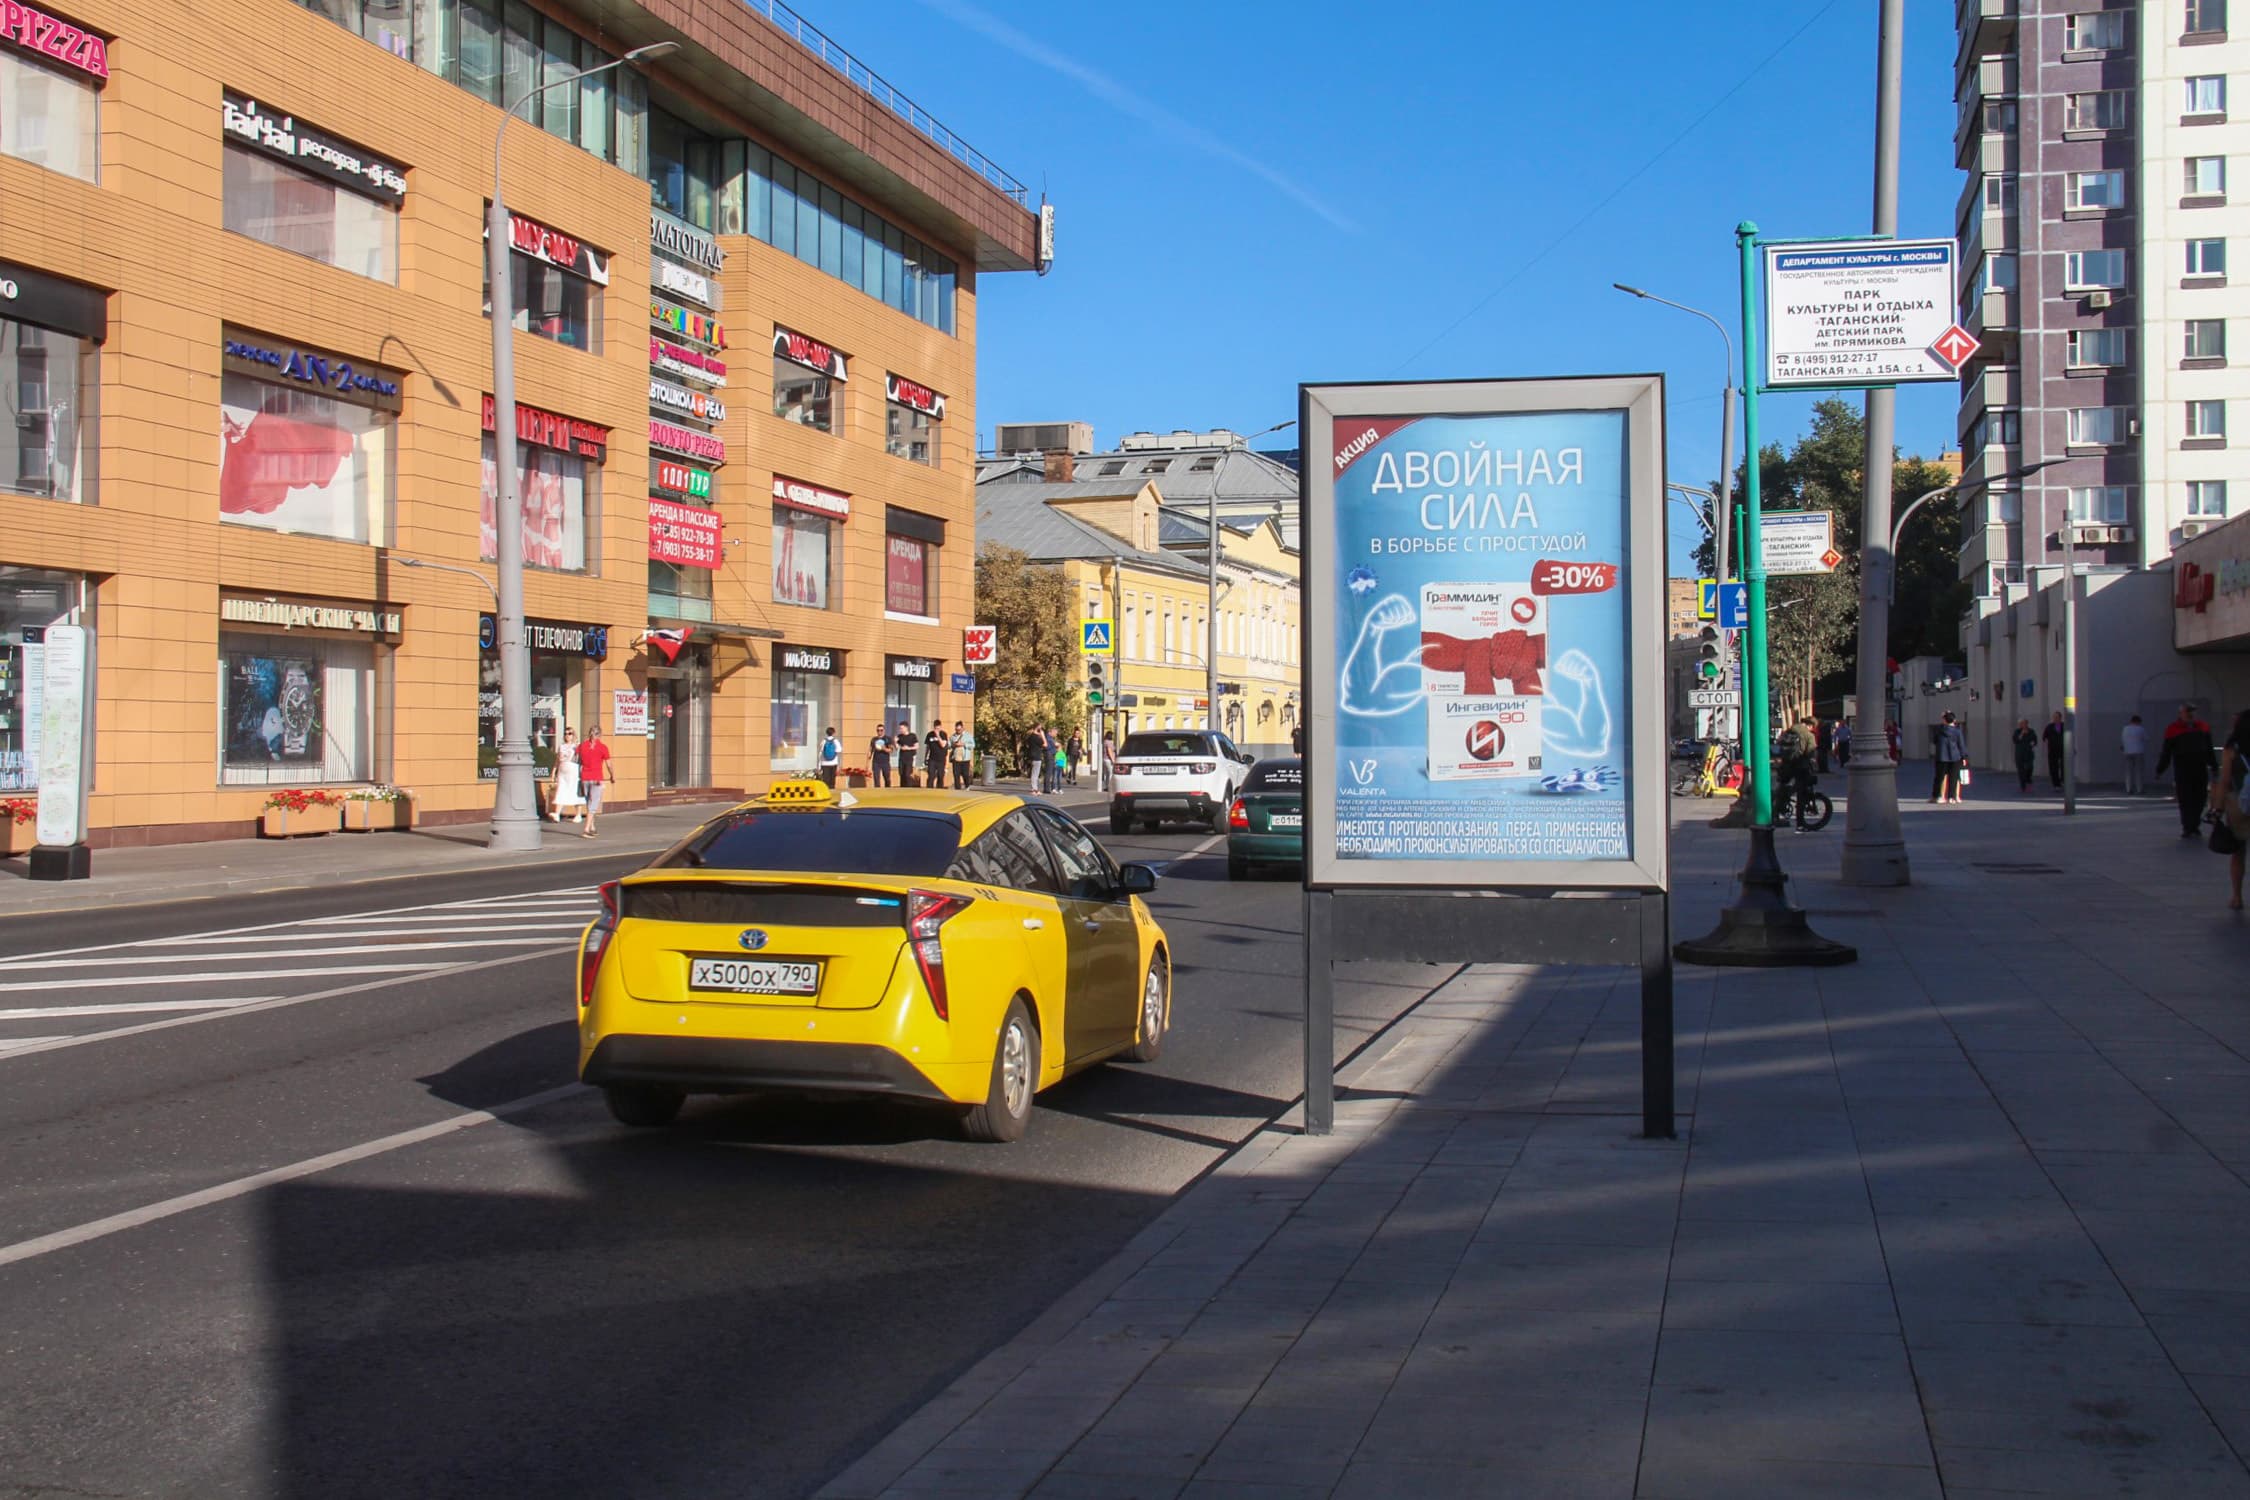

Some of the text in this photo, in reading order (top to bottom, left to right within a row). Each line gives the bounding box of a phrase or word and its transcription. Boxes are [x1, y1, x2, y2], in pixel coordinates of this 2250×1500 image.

[2, 0, 109, 78] PIZZA
[1782, 256, 1846, 268] ДЕПАРТАМЕНТ
[1846, 254, 1891, 264] КУЛЬТУРЫ
[1901, 252, 1943, 262] МОСКВЫ
[1779, 266, 1943, 280] ГОСУДАРСТВЕННОЕ АВТОНОМНОЕ УЧРЕЖДЕНИЕ
[1866, 277, 1899, 285] МОСКВЫ
[1844, 290, 1881, 300] ПАРК
[1787, 300, 1934, 315] КУЛЬТУРЫ И ОТДЫХА
[1816, 326, 1904, 338] ДЕТСКИЙ ПАРК
[1833, 337, 1907, 348] ПРЯМИКОВА
[1794, 353, 1878, 365] 8 (495) 912-27-17
[280, 348, 354, 393] AN-2
[1777, 366, 1844, 377] ТАГАНСКАЯ
[1918, 364, 1924, 372] 1
[649, 382, 696, 412] ВТОШКОЛА
[1334, 427, 1380, 470] АКЦИЯ
[1371, 440, 1583, 494] ДВОЙНАЯ
[650, 502, 718, 530] АРЕНДА В ПАССАЖЕ
[1420, 493, 1539, 531] СИЛА
[663, 523, 680, 541] (85)
[890, 538, 923, 563] АРЕНДА
[1370, 531, 1587, 554] В БОРЬБЕ С ПРОСТУДОЙ
[221, 597, 401, 634] ШВЕЙЦАРСКИЕ ЧАСЫ
[534, 626, 584, 651] ТЕЛЕФОНОВ
[1696, 692, 1733, 704] СТОП
[1339, 787, 1387, 796] VALENTA
[1336, 820, 1626, 838] ИМЕЮТСЯ ПРОТИВОПОКАЗАНИЯ. ПЕРЕД ПРИМЕНЕНИЕМ
[1335, 838, 1626, 855] НЕОБХОДИМО ПРОКОНСУЛЬТИРОВАТЬСЯ СО СПЕЦИАЛИСТОМ.
[781, 965, 812, 982] 790
